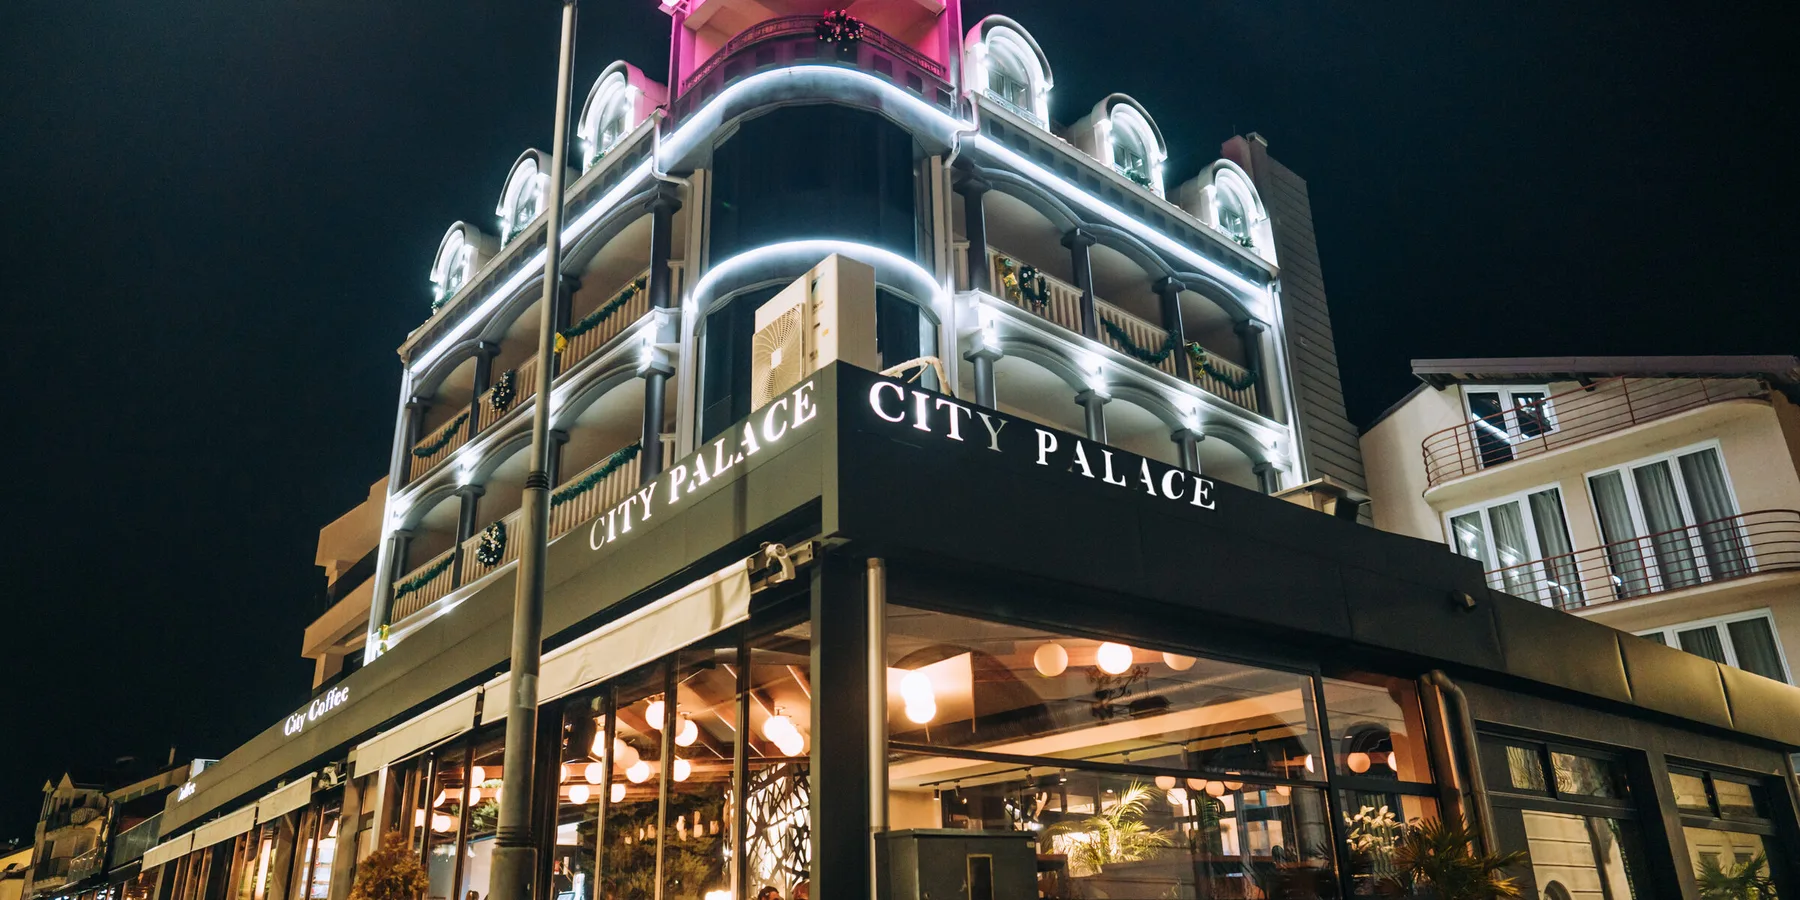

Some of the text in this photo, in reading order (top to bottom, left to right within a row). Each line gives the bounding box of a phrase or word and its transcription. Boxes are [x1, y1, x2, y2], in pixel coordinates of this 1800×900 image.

[589, 380, 816, 551] CITY PALACE
[868, 380, 1216, 510] CITY PALACE
[284, 686, 349, 736] City Coffee
